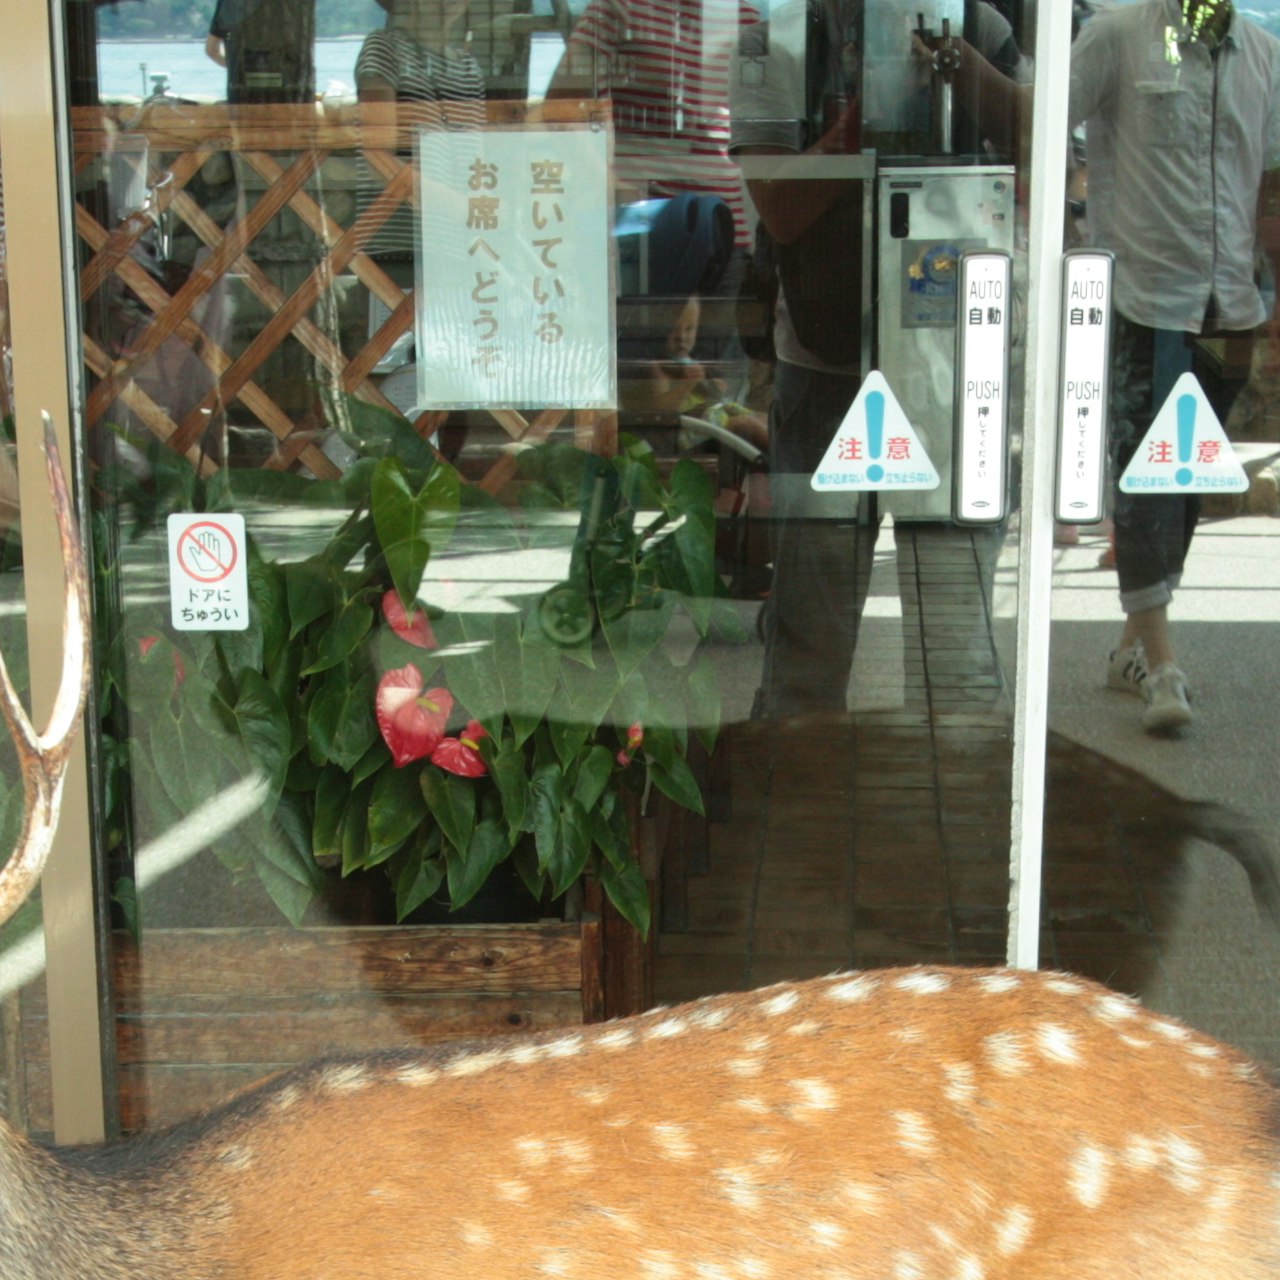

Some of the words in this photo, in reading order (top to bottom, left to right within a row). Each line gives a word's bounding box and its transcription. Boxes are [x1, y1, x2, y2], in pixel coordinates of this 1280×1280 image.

[530, 159, 565, 345] 空いている
[466, 158, 503, 380] お席へどうぞ
[970, 280, 1003, 300] AUTO
[1071, 280, 1104, 300] AUTO
[969, 306, 1002, 326] 自動
[1070, 306, 1103, 326] 自動
[967, 380, 1000, 400] PUSH
[1067, 381, 1100, 400] PUSH
[838, 437, 912, 460] 注意
[977, 406, 990, 478] 押してください
[1076, 406, 1090, 479] 押してください
[1148, 440, 1221, 463] 注意
[188, 588, 232, 603] ドアに
[181, 606, 239, 622] ちゅうい
